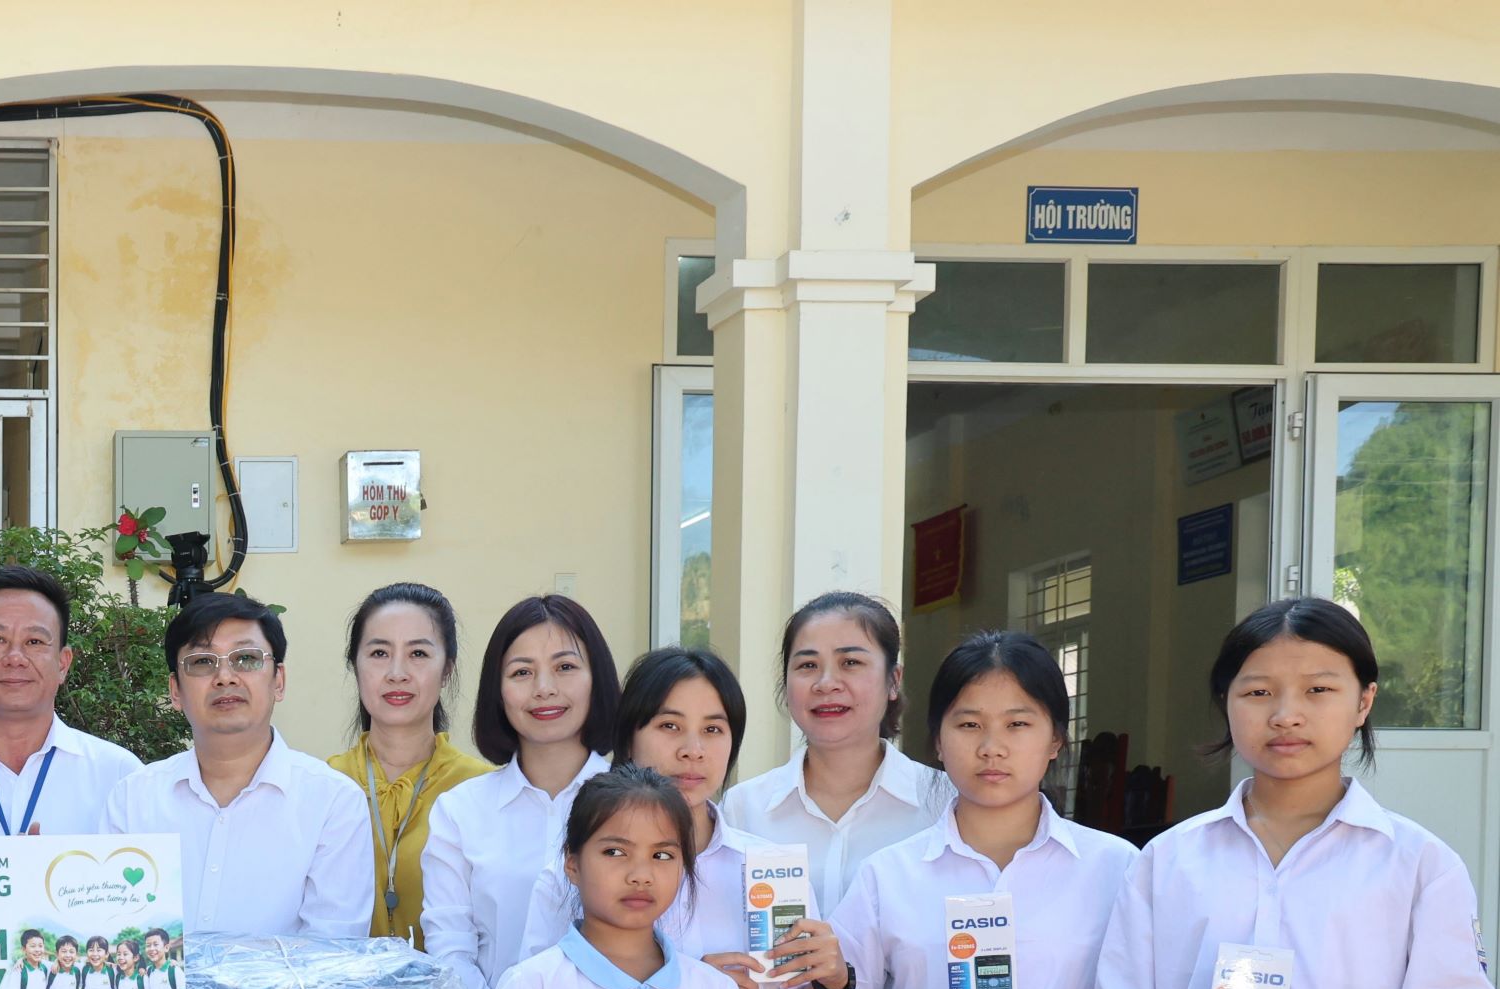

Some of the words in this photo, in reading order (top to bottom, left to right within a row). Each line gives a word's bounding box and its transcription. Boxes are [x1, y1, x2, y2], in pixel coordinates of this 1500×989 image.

[1034, 200, 1062, 234] HỘI
[1066, 199, 1132, 230] TRƯỜNG
[752, 867, 803, 880] CASIO
[951, 917, 1008, 930] CASIO
[1221, 969, 1284, 986] CSIO
